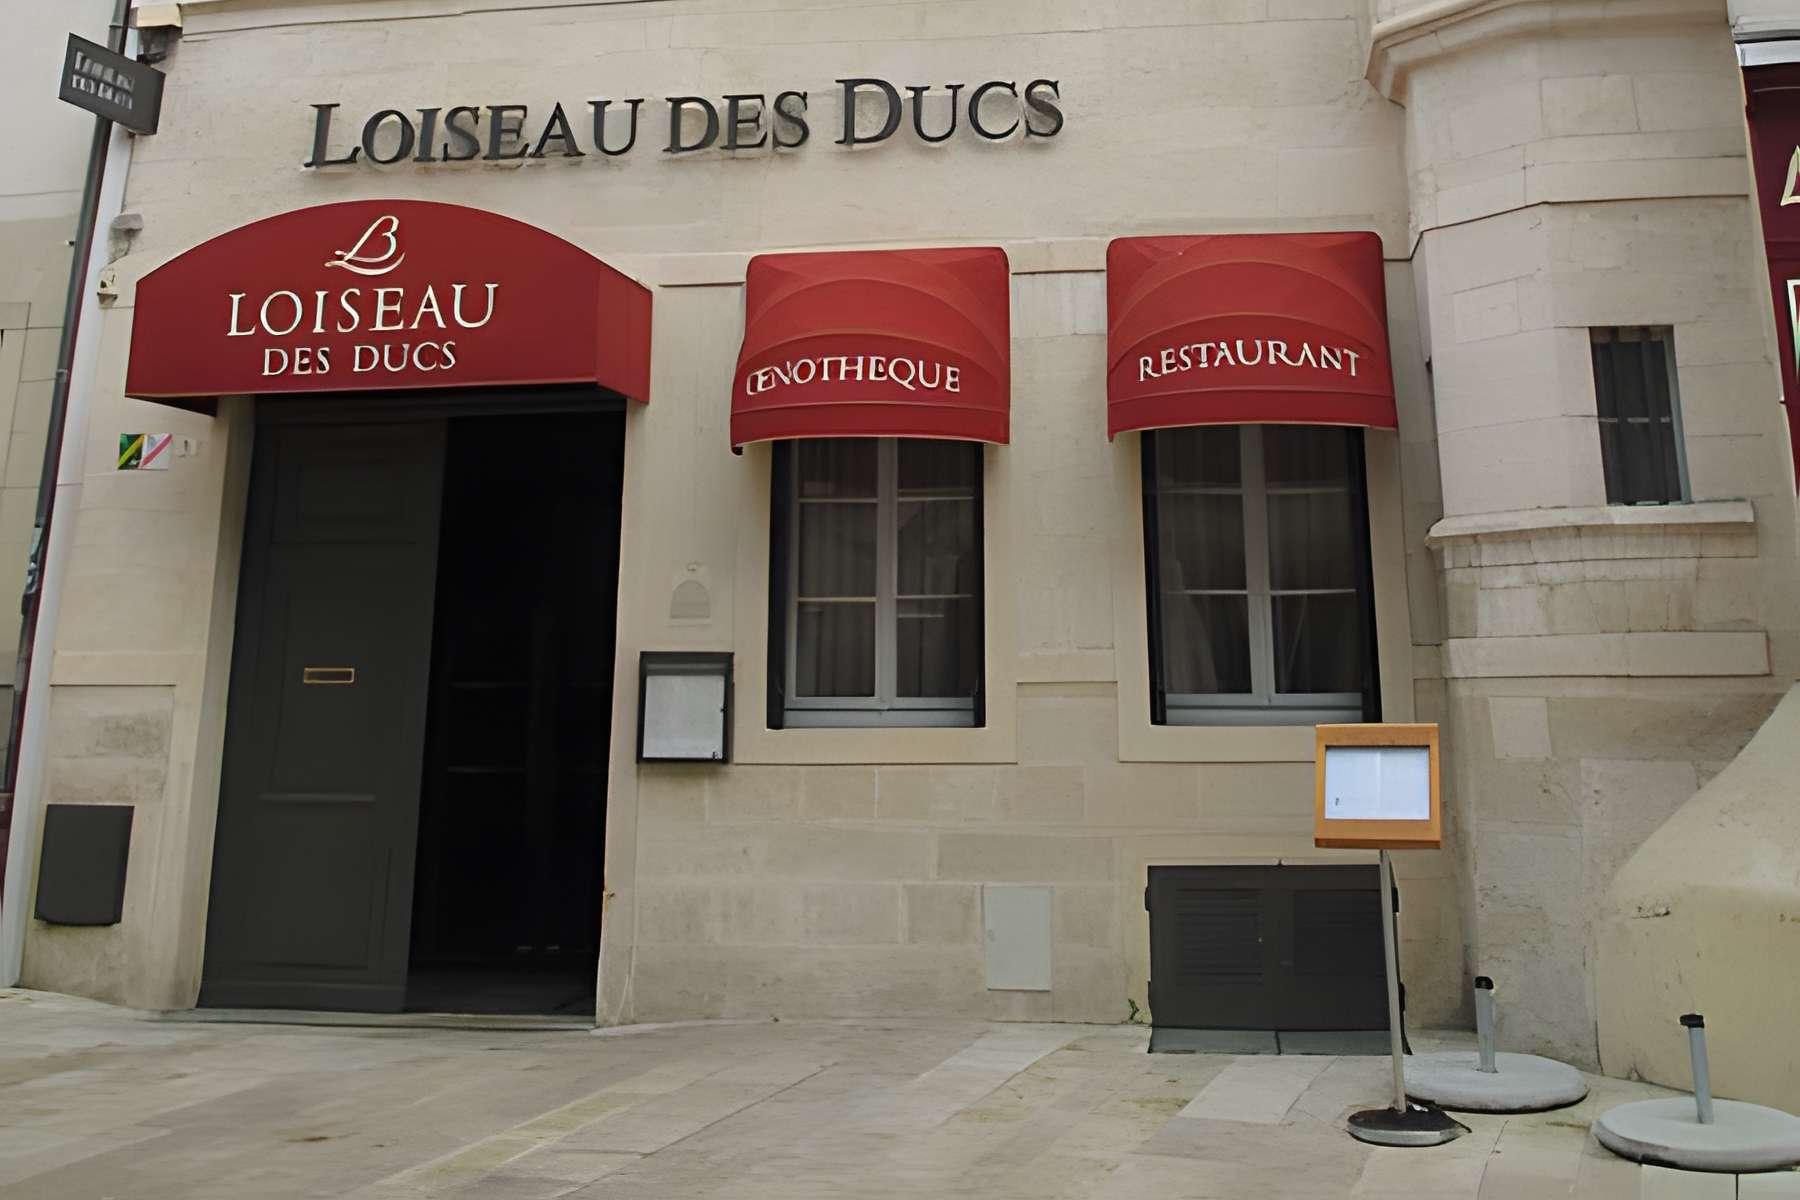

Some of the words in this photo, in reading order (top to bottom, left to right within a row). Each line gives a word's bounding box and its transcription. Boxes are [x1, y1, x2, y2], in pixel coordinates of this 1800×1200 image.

[304, 97, 645, 168] LOISEAU
[662, 90, 810, 153] DES
[834, 77, 1064, 145] DUCS
[227, 283, 499, 336] LOISEAU
[262, 347, 331, 376] DES
[352, 341, 457, 373] DUCS
[1137, 339, 1361, 382] RESTAURANT
